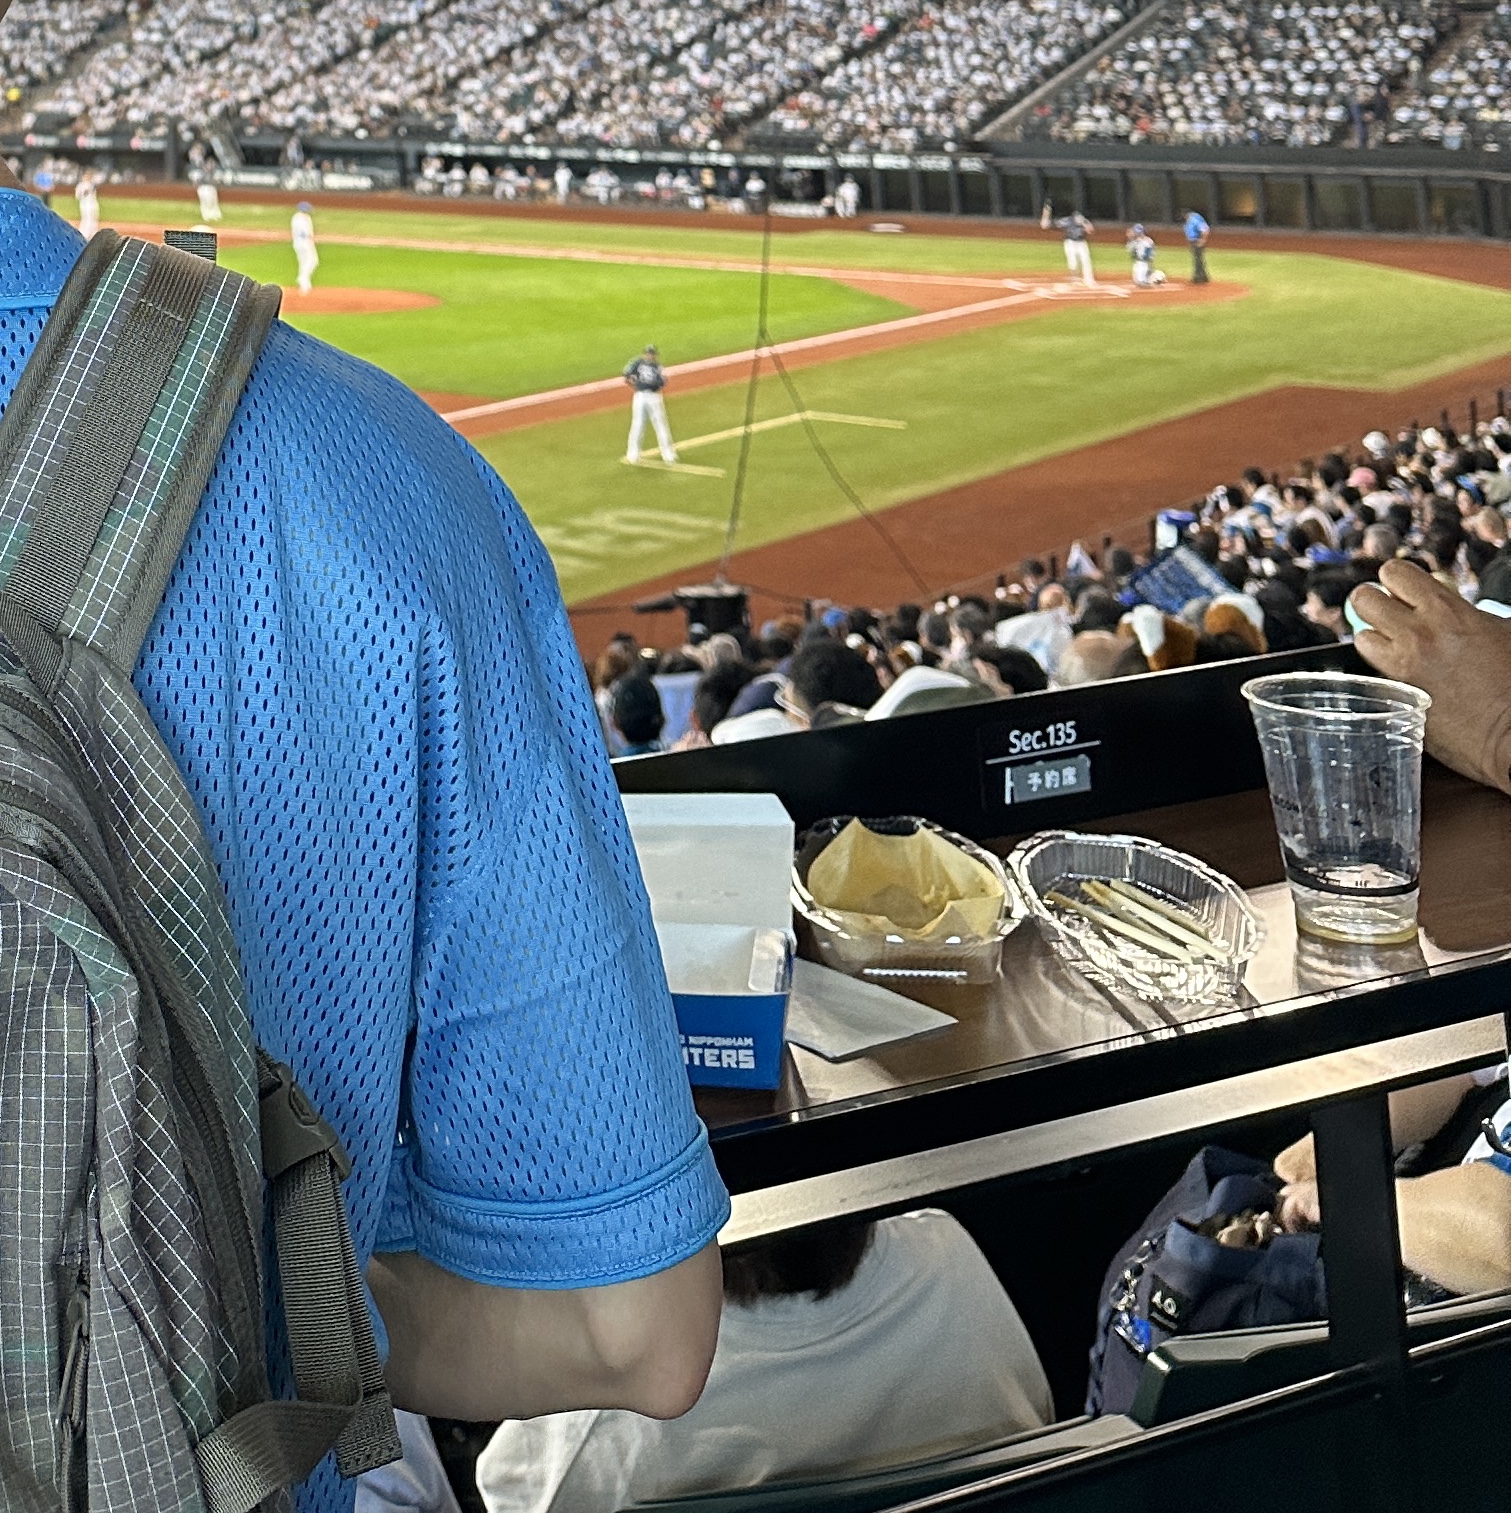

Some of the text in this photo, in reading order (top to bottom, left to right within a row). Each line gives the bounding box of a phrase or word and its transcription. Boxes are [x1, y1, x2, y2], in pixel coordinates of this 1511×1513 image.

[1008, 720, 1077, 754] Sec.135
[1027, 765, 1077, 792] 予約席
[688, 1035, 754, 1047] NIPPONHAM
